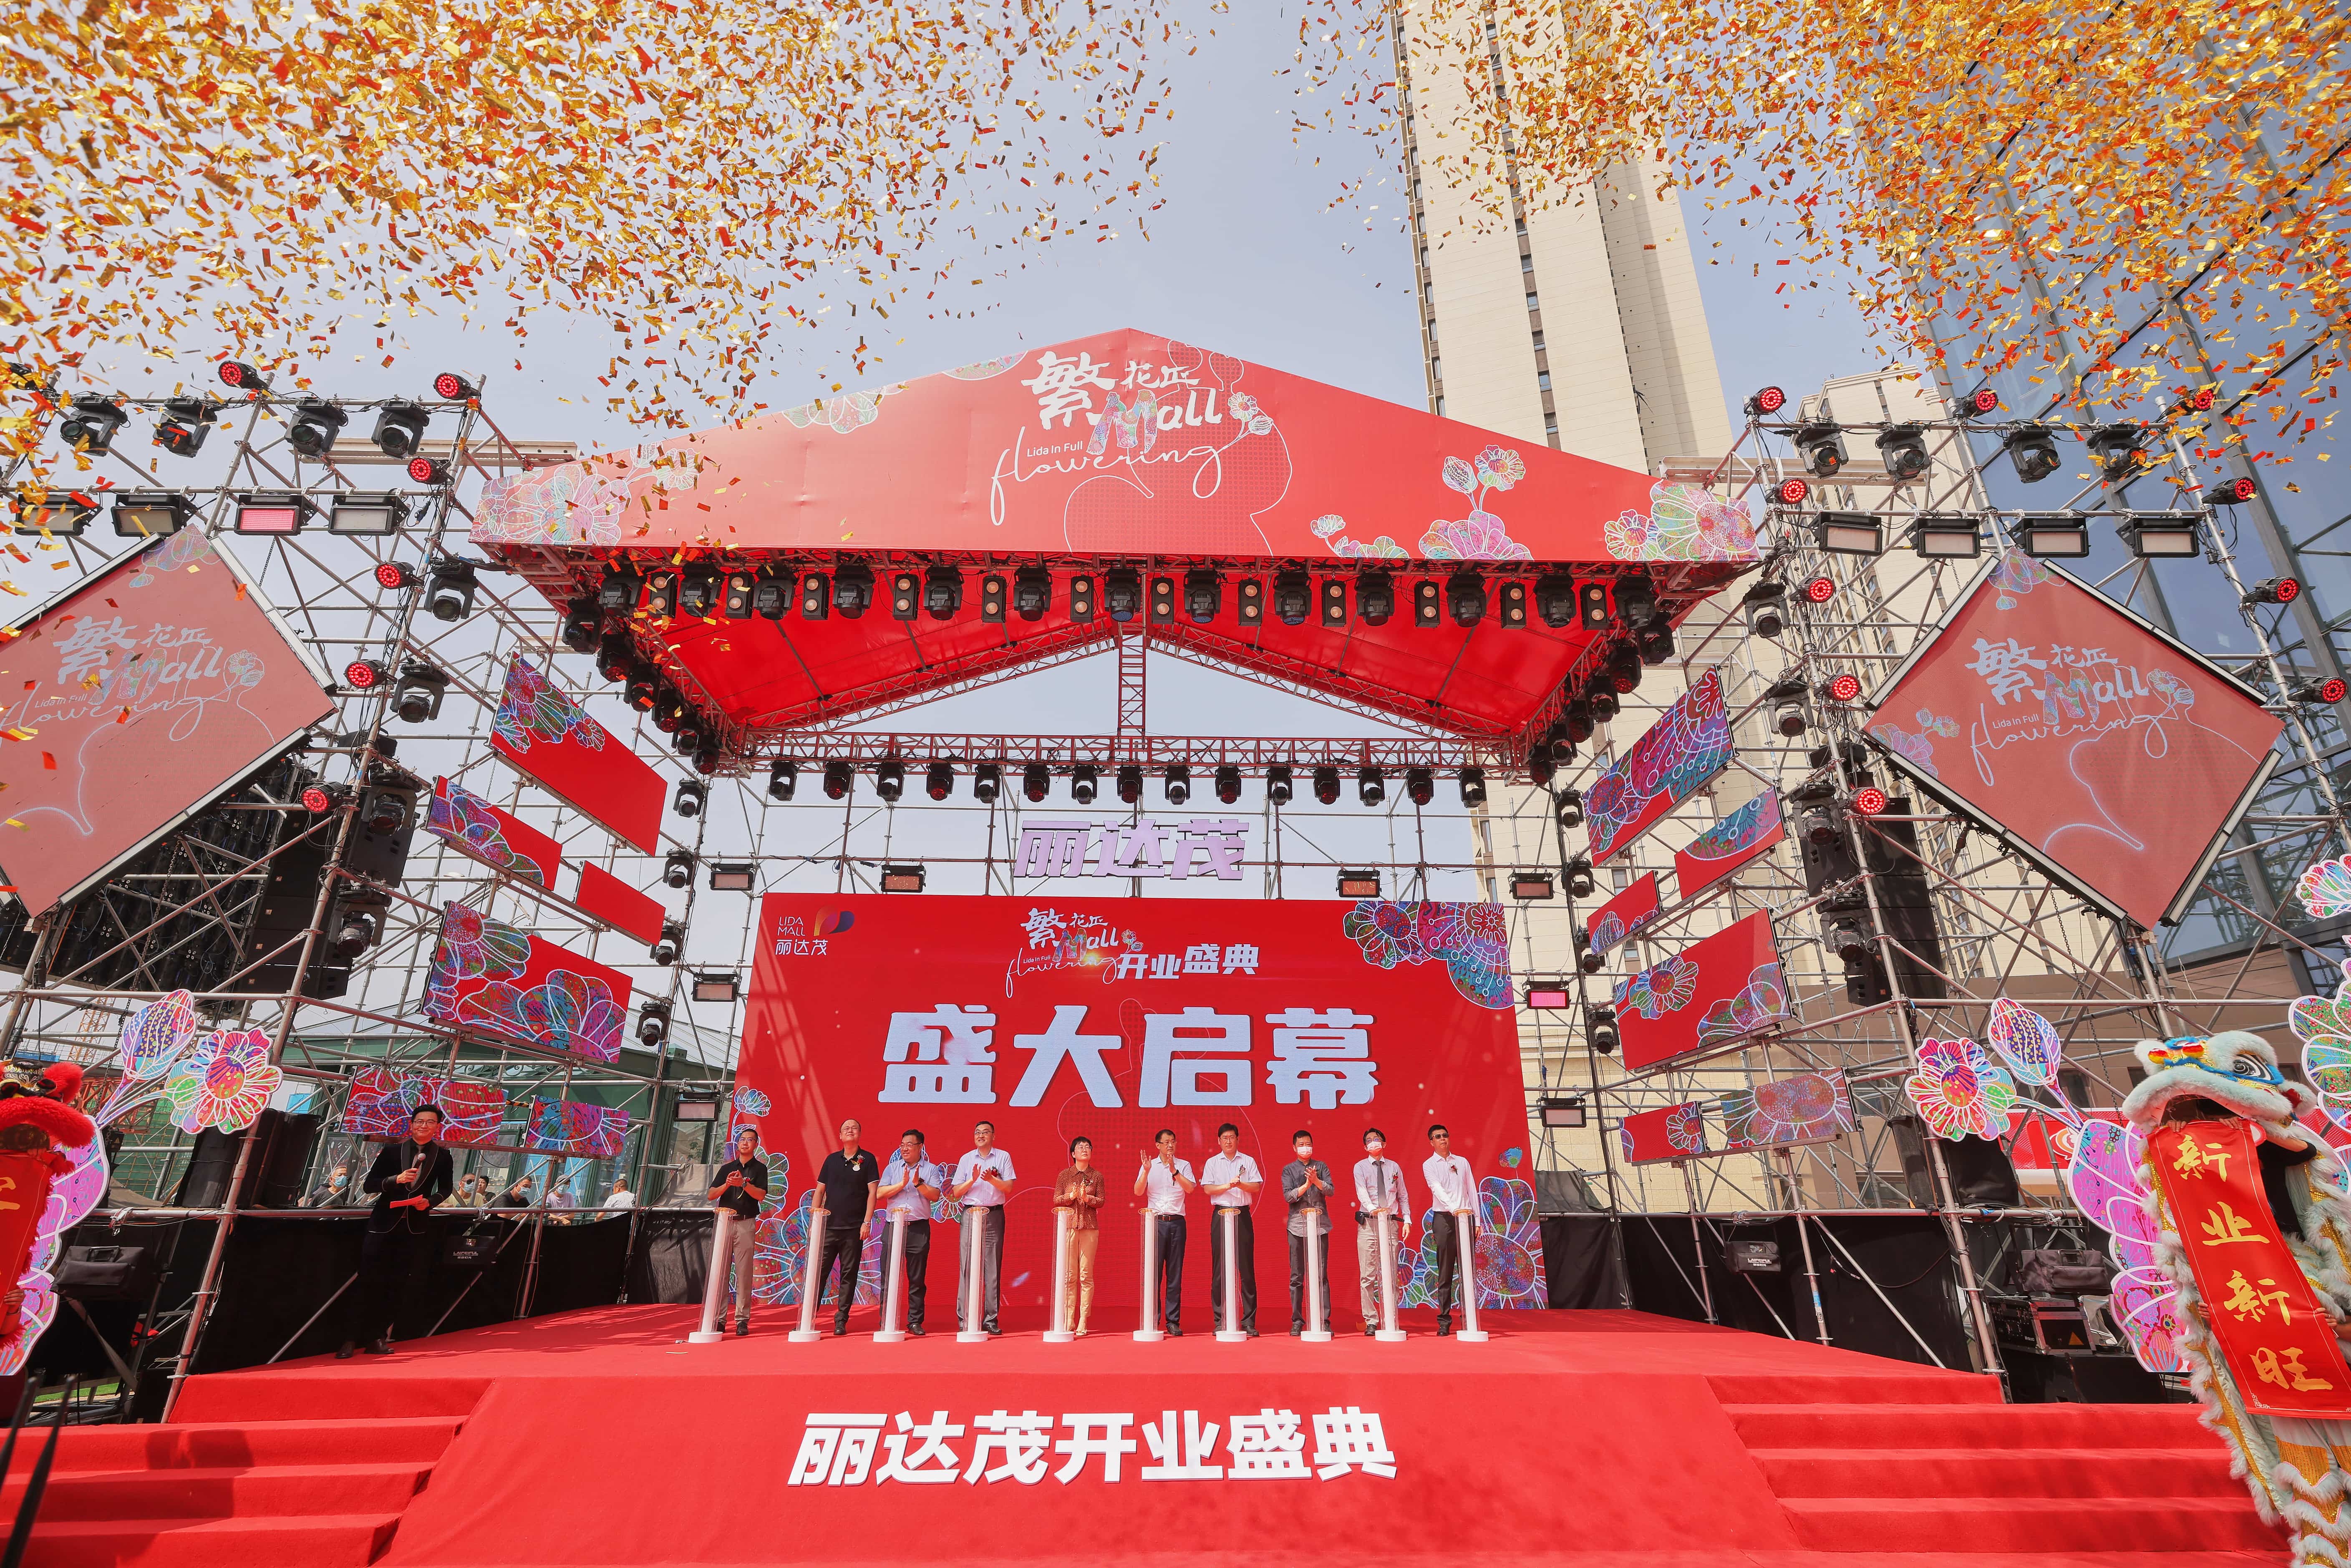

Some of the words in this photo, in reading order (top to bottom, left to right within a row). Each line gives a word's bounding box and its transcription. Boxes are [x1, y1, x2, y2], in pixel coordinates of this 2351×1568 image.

[1086, 388, 1222, 455] Mall
[990, 426, 1222, 526] flowering
[1027, 447, 1049, 457] Lida
[1051, 445, 1061, 454] In
[1063, 441, 1083, 452] Full
[35, 698, 55, 708] Lida
[88, 647, 223, 705] Mall
[2043, 666, 2149, 725] Mall
[1970, 703, 2167, 787] flowering
[1993, 719, 2011, 729] Lida
[2023, 713, 2039, 724] Full
[1014, 819, 1249, 880] 丽达茂
[775, 938, 828, 955] 丽达茂
[777, 926, 806, 936] MALL
[779, 916, 804, 926] LIDA
[1052, 927, 1119, 962] Mall
[1005, 947, 1121, 998] flowering
[1117, 943, 1259, 979] 开业盛典
[878, 1003, 1378, 1110] 盛大启幕
[2173, 1134, 2333, 1392] 新业新旺
[787, 1405, 1397, 1487] 丽达茂开业盛典
